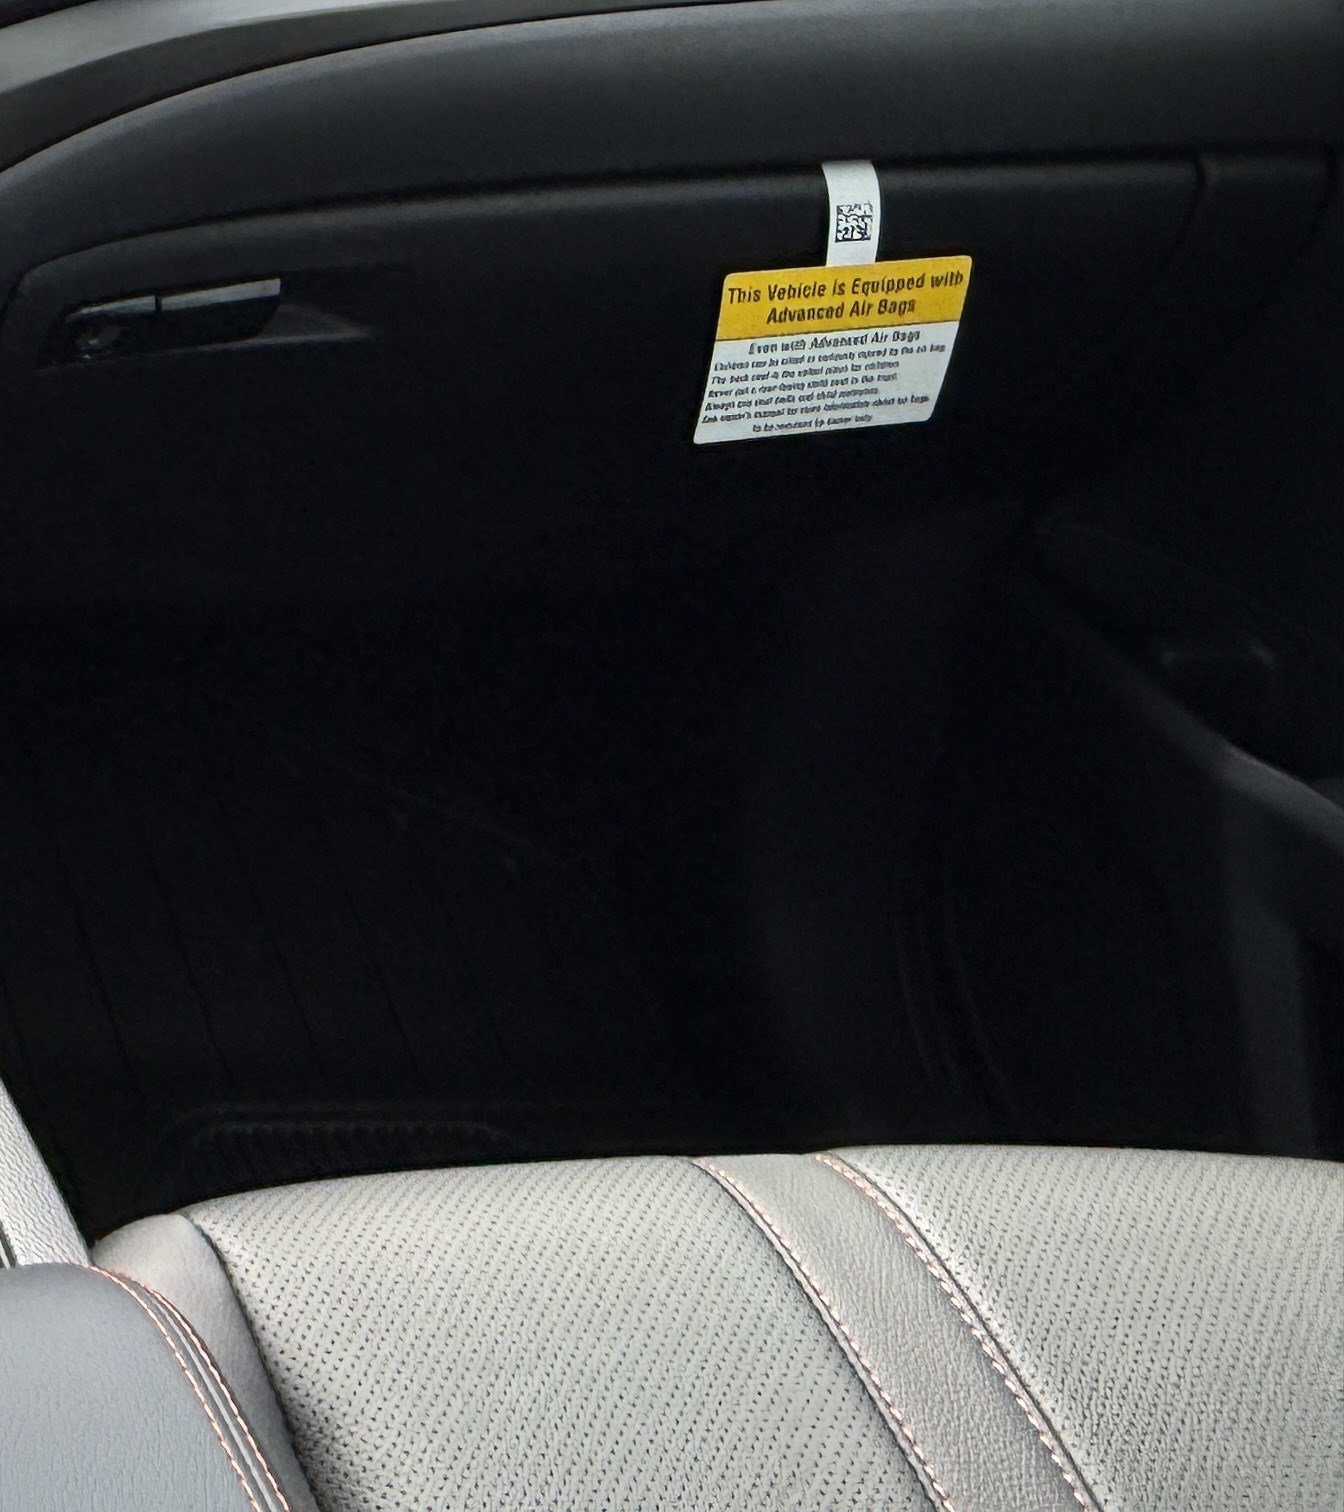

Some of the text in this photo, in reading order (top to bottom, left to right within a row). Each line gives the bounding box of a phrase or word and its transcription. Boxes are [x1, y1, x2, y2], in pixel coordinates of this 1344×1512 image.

[728, 270, 965, 304] This Vehicle is Equipped with
[766, 298, 916, 324] Advanced Air Bags
[871, 331, 888, 343] Air
